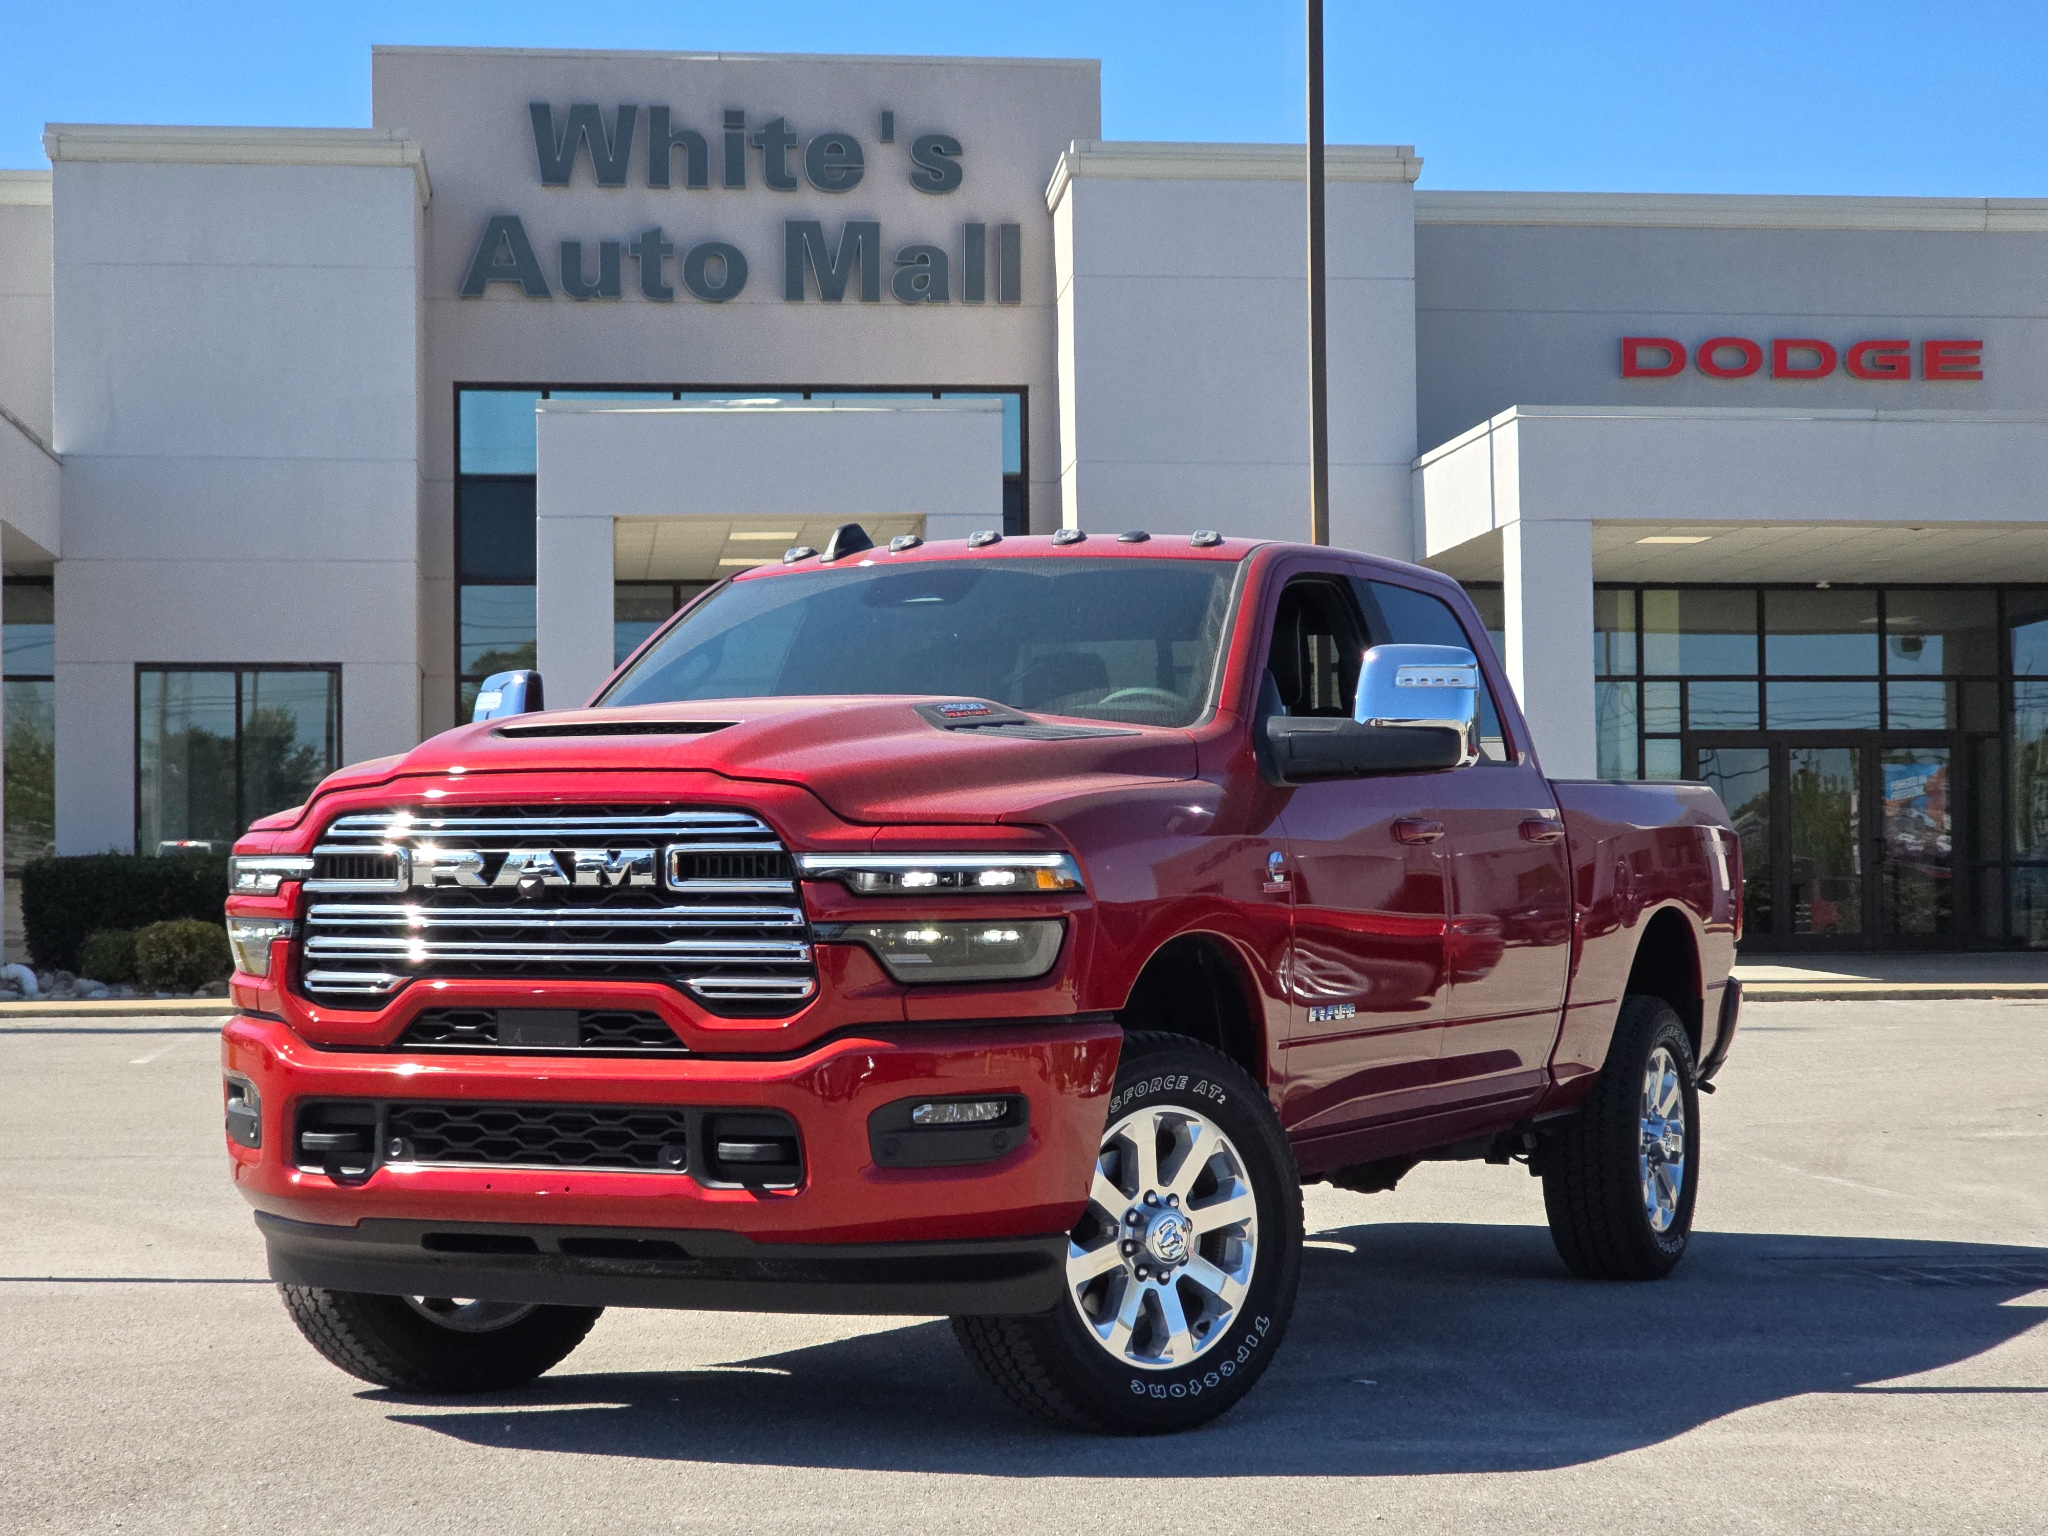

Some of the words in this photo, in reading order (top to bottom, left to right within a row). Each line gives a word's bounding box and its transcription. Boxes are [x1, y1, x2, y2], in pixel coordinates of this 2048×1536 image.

[528, 101, 964, 195] White's
[459, 214, 749, 301] Auto
[783, 219, 1022, 304] Mall
[1621, 336, 1984, 381] DODGE
[410, 849, 657, 888] RAM
[1130, 1315, 1270, 1399] Firestone
